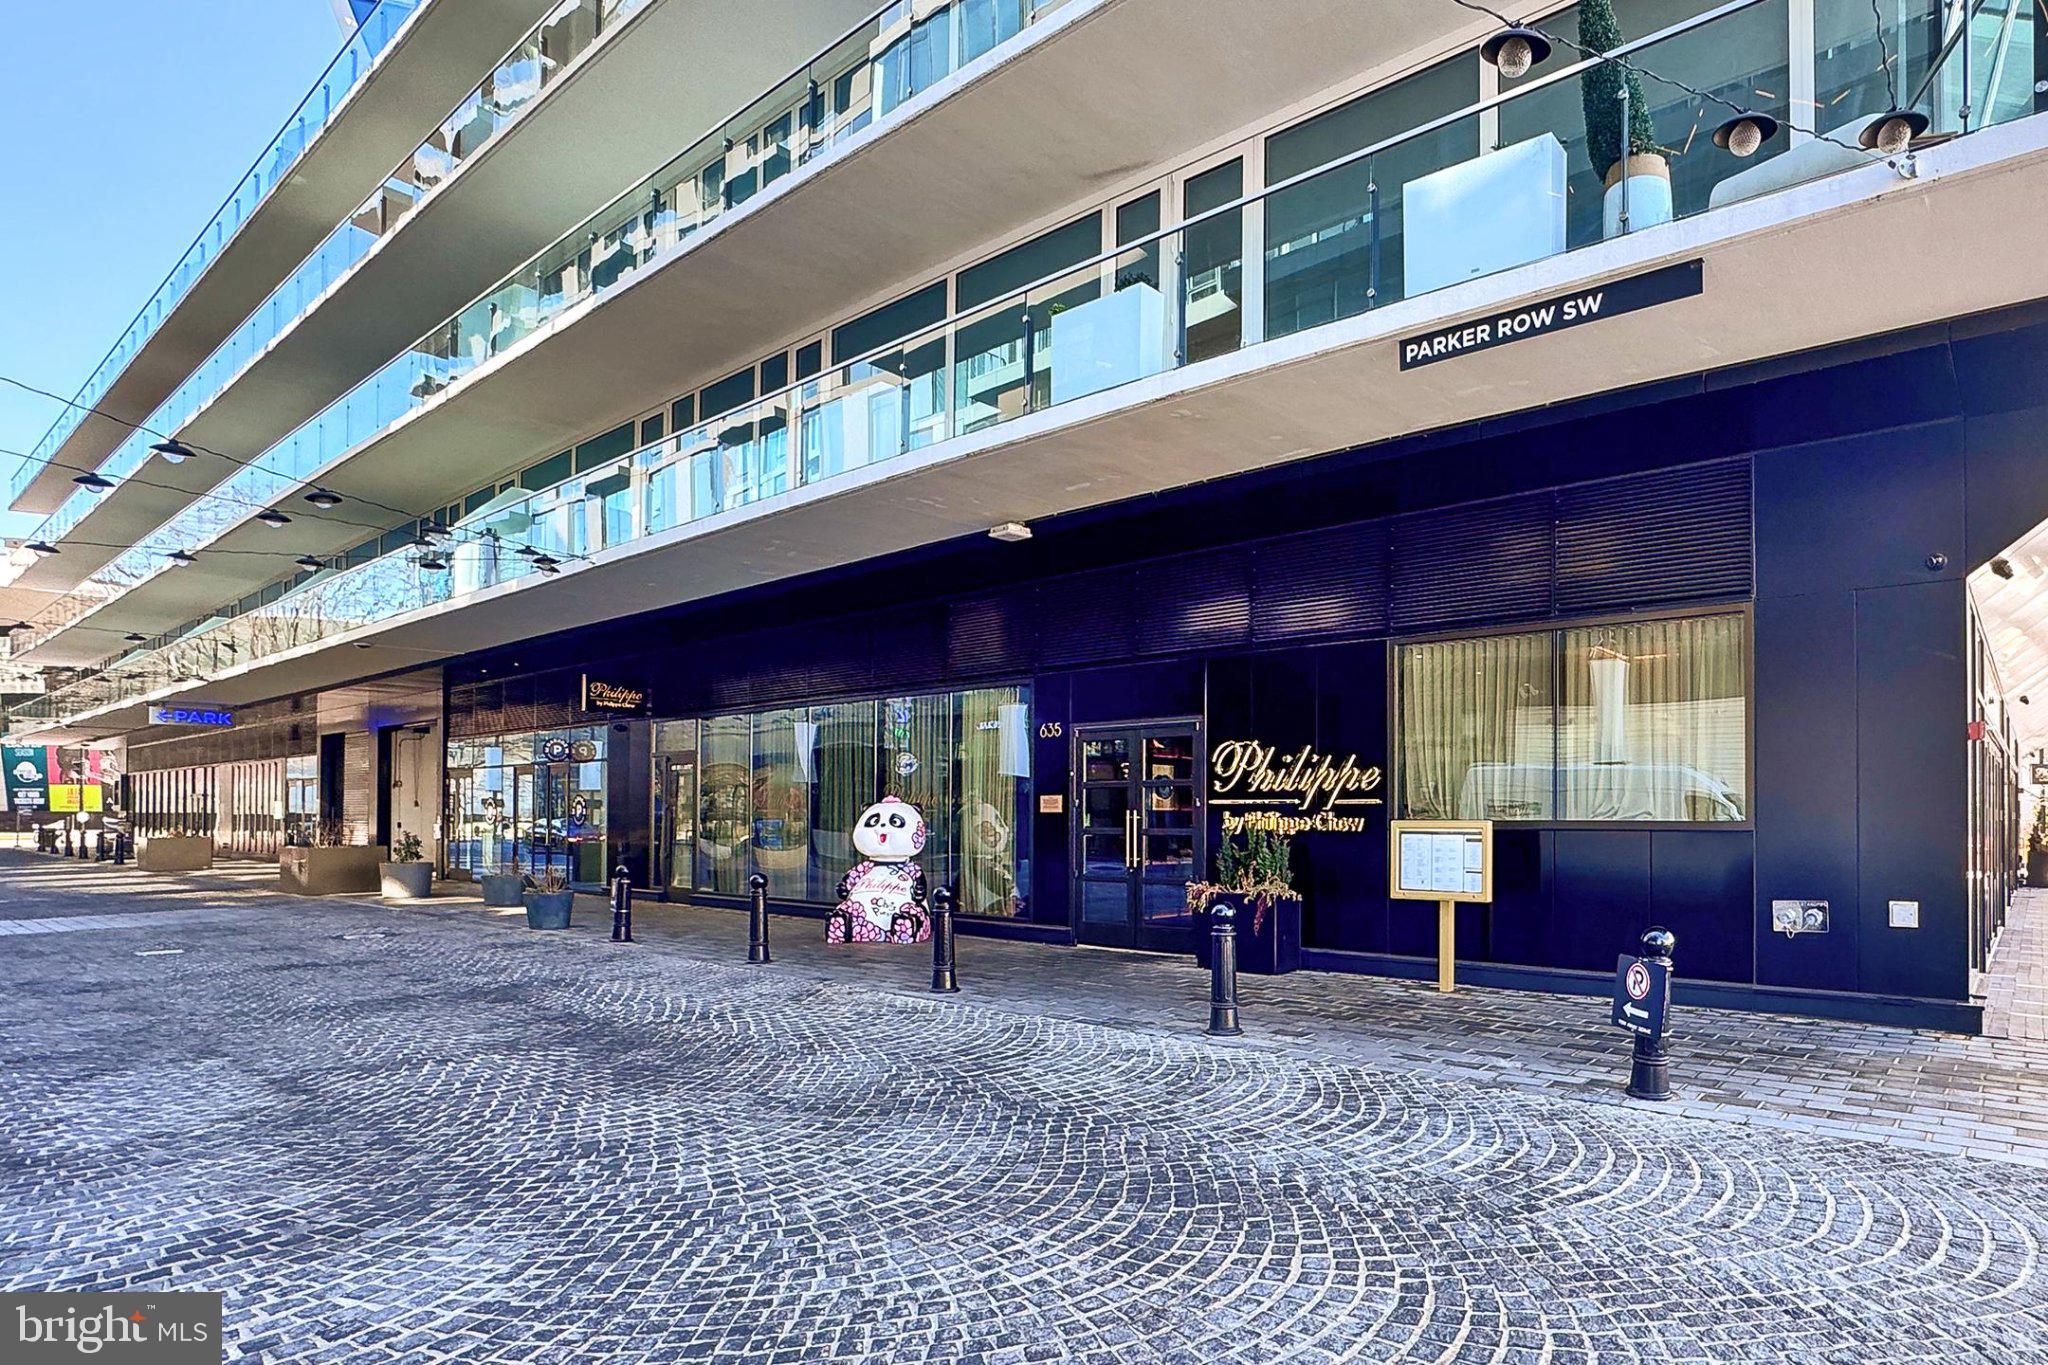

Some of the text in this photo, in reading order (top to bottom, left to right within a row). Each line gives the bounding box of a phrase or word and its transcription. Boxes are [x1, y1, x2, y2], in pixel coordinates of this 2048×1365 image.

[1405, 292, 1604, 362] PARKER ROW SW
[590, 681, 643, 703] Philippe
[174, 710, 233, 726] PARK
[1039, 722, 1062, 738] 635
[1212, 740, 1382, 810] Philippe
[1222, 811, 1244, 834] by
[1312, 811, 1365, 832] Chow
